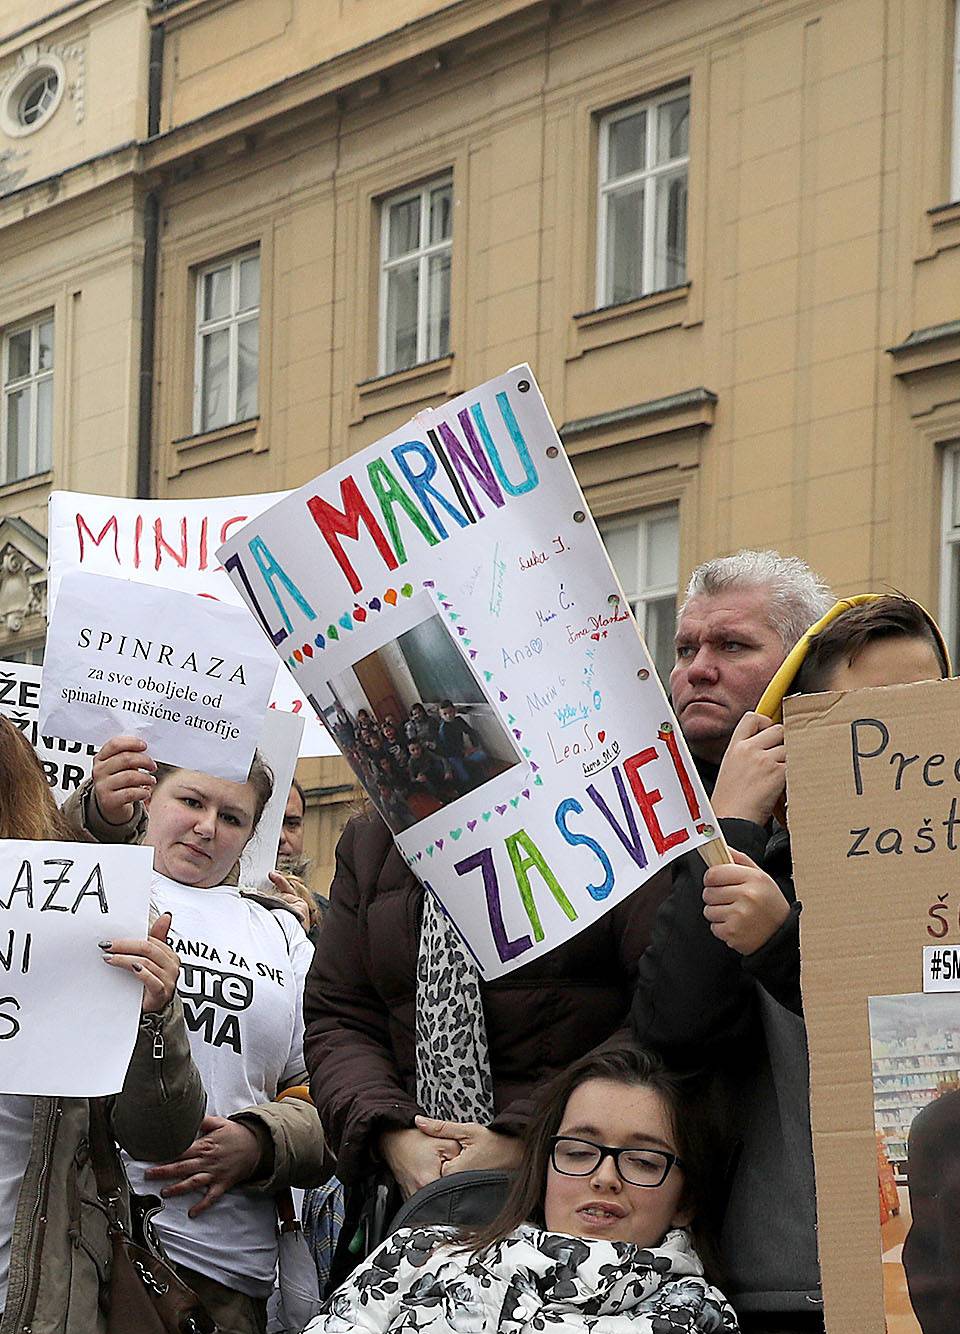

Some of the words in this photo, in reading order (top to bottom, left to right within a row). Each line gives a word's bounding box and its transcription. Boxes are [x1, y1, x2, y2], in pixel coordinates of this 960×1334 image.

[224, 534, 317, 647] ZA
[306, 391, 541, 596] MARINU
[77, 628, 247, 686] SPINRAZA
[61, 686, 119, 708] spinalne
[122, 698, 181, 723] mišićne
[184, 716, 240, 741] atrofije
[88, 667, 104, 680] za
[107, 671, 133, 686] sve
[137, 676, 198, 702] oboljele
[202, 694, 223, 708] od
[453, 828, 579, 964] ZA
[228, 950, 250, 972] ZA
[256, 962, 285, 988] SVE
